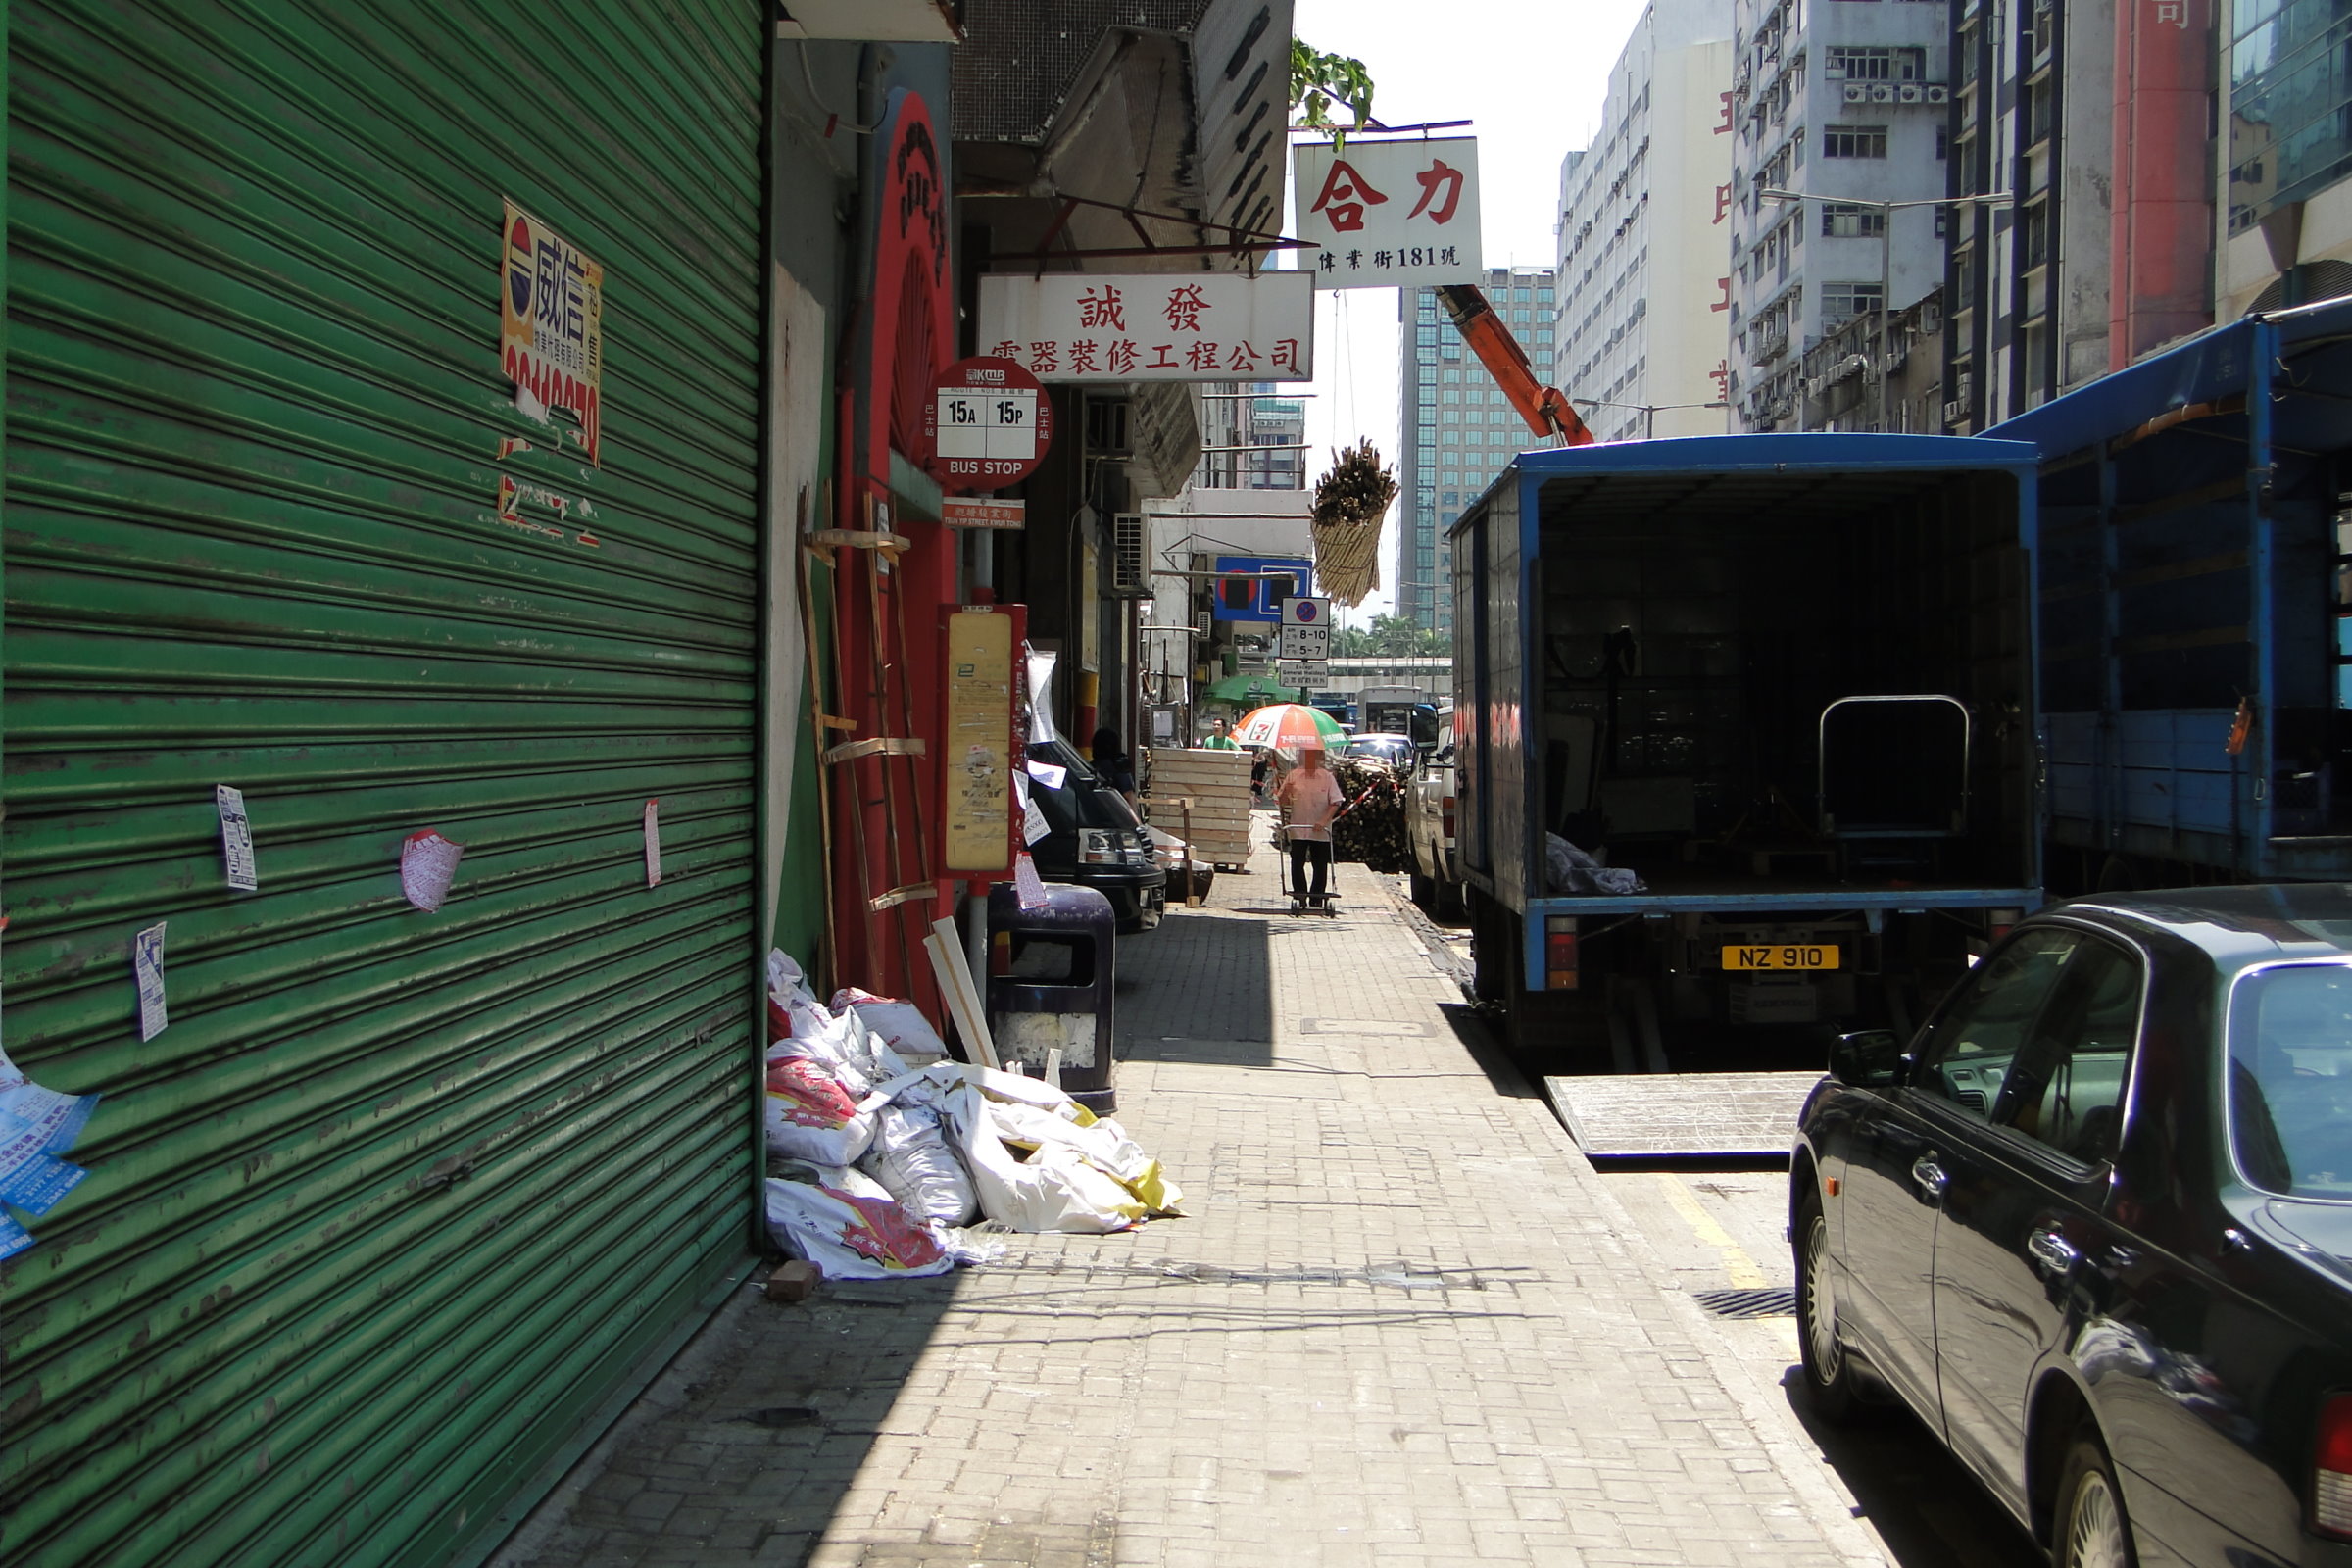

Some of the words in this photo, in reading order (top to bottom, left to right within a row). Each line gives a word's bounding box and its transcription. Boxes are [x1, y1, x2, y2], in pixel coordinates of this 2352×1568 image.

[1310, 159, 1464, 233] 合力
[1319, 246, 1460, 274] 偉業街181號
[535, 237, 587, 348] 威信
[1077, 282, 1212, 332] 誠發
[990, 338, 1301, 375] 電器裝修工程公司
[978, 369, 1005, 382] KMB
[925, 404, 935, 437] 巴士站
[949, 400, 976, 424] 15A
[996, 401, 1023, 425] 15P
[1039, 407, 1050, 440] 巴士站
[950, 461, 979, 474] BUS
[984, 462, 1023, 475] STOP
[1005, 519, 1022, 528] TONG
[1299, 629, 1326, 640] 8-10
[1740, 948, 1771, 967] NZ
[1783, 948, 1823, 967] 910
